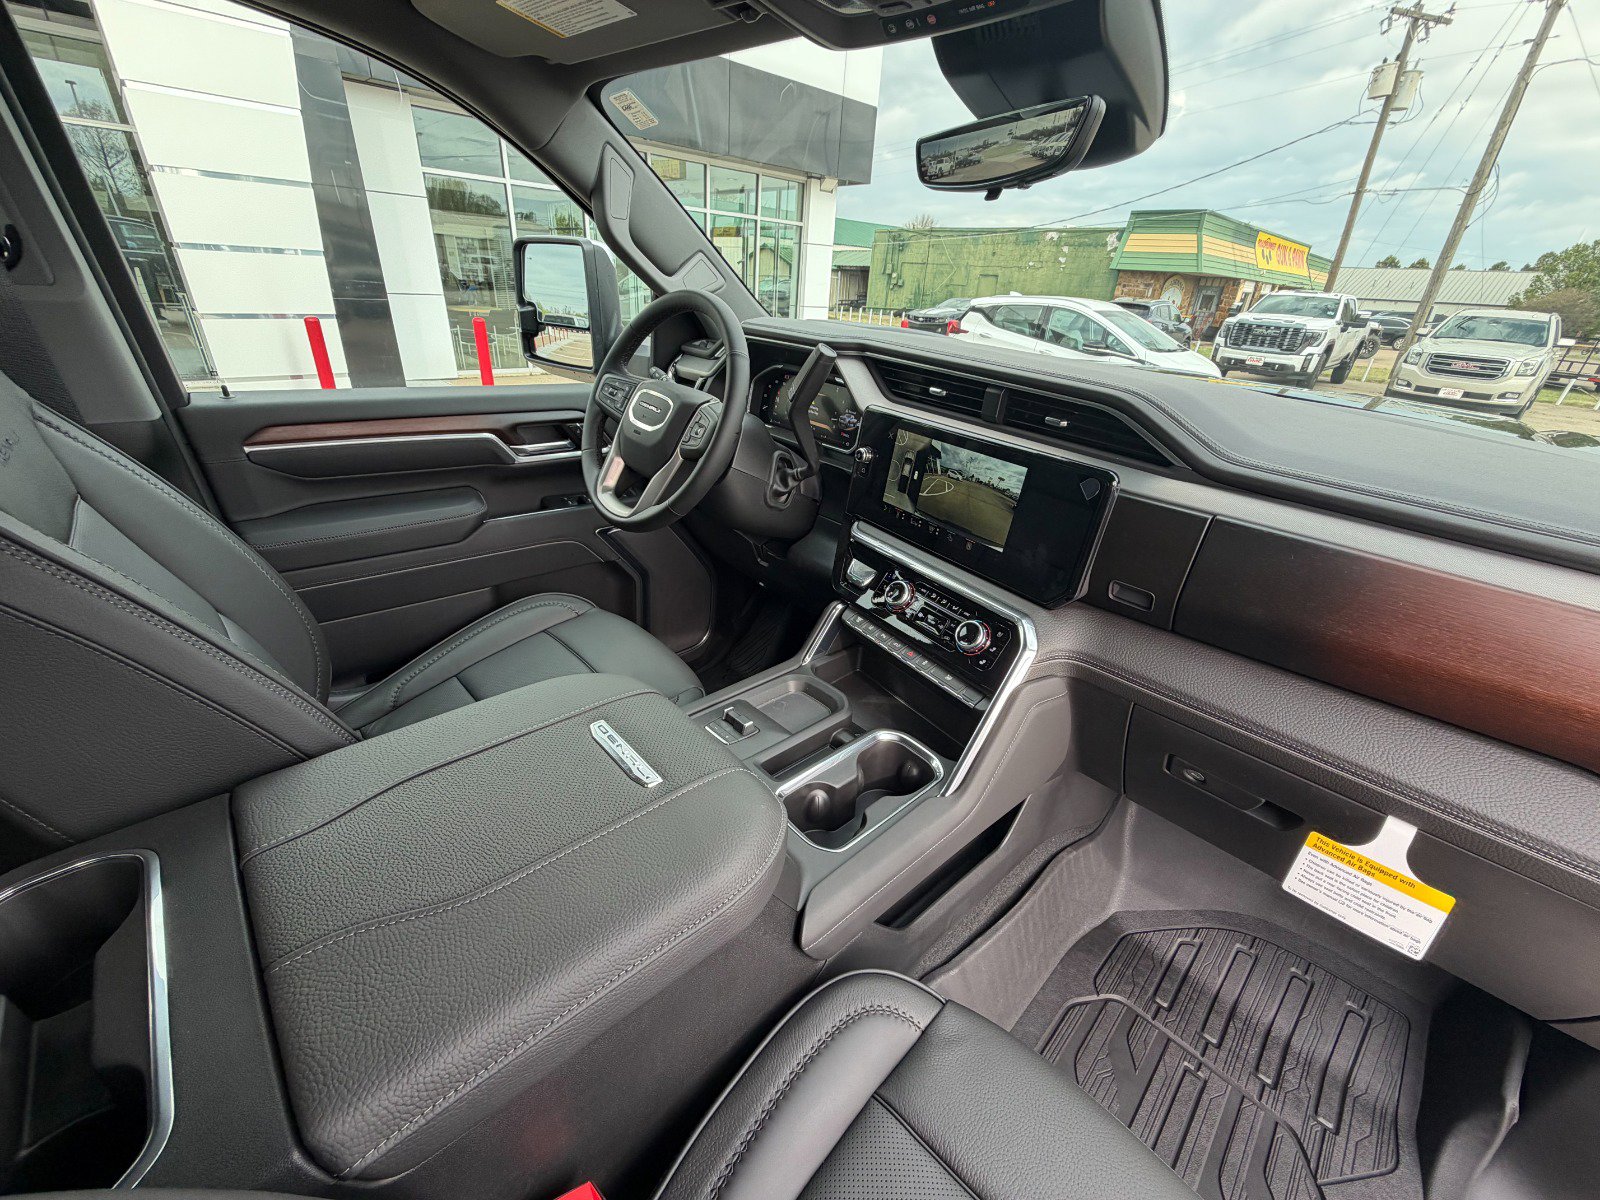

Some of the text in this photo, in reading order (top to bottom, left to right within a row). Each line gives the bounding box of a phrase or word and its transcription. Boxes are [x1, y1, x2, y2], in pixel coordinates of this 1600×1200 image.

[1313, 842, 1376, 877] Advanced Air Bags
[1316, 837, 1330, 847] This
[1331, 844, 1356, 859] Vehicle
[1365, 861, 1398, 880] Equipped
[1399, 877, 1415, 888] with
